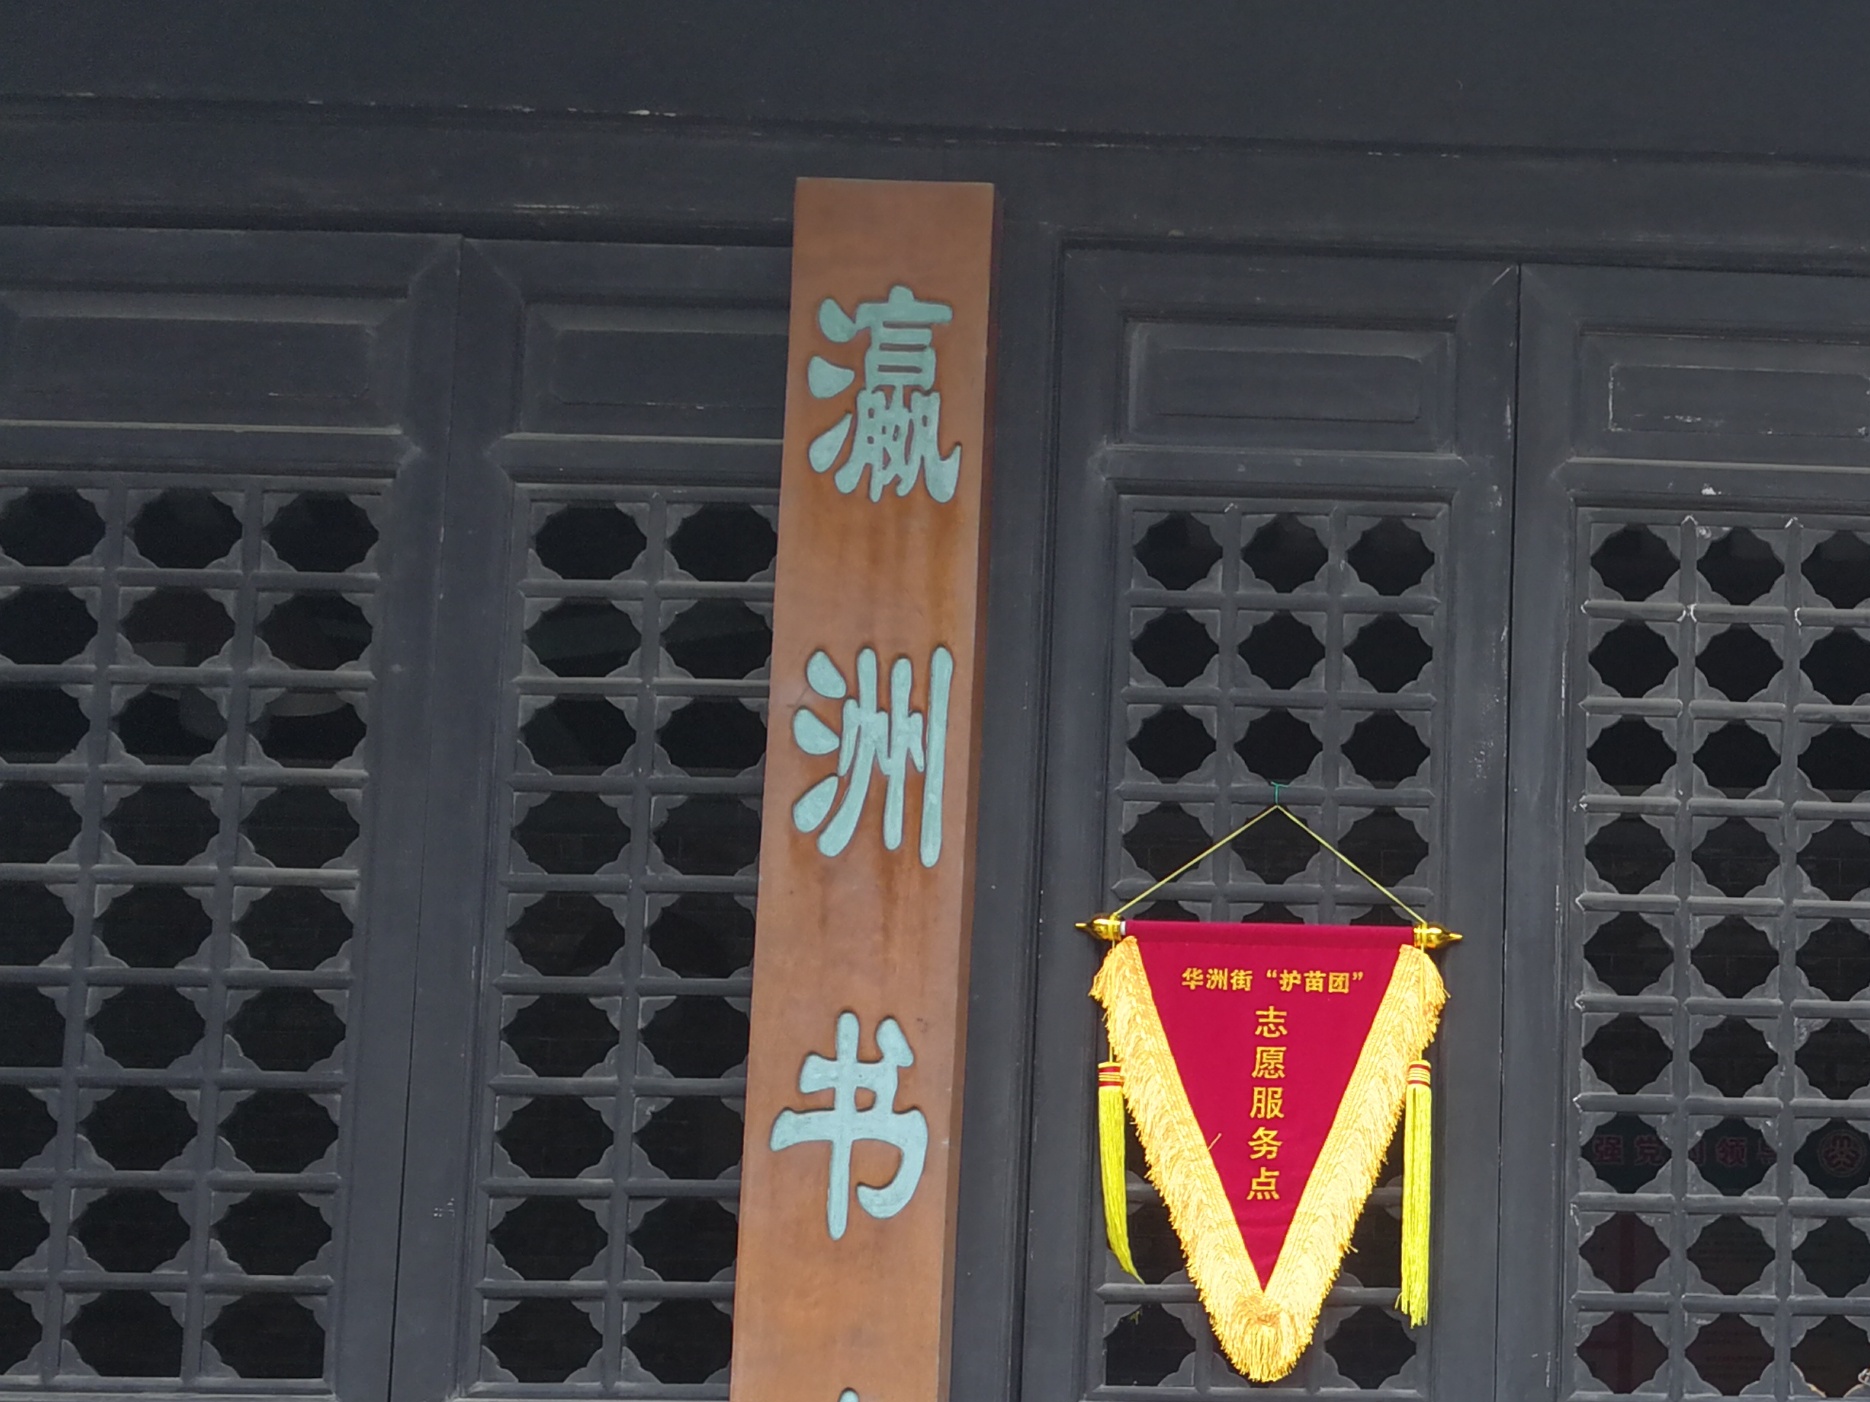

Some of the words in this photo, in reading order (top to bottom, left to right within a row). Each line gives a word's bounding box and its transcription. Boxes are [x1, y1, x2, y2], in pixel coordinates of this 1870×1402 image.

[1181, 968, 1253, 992] 华洲街
[1247, 1006, 1288, 1201] 志愿服务点
